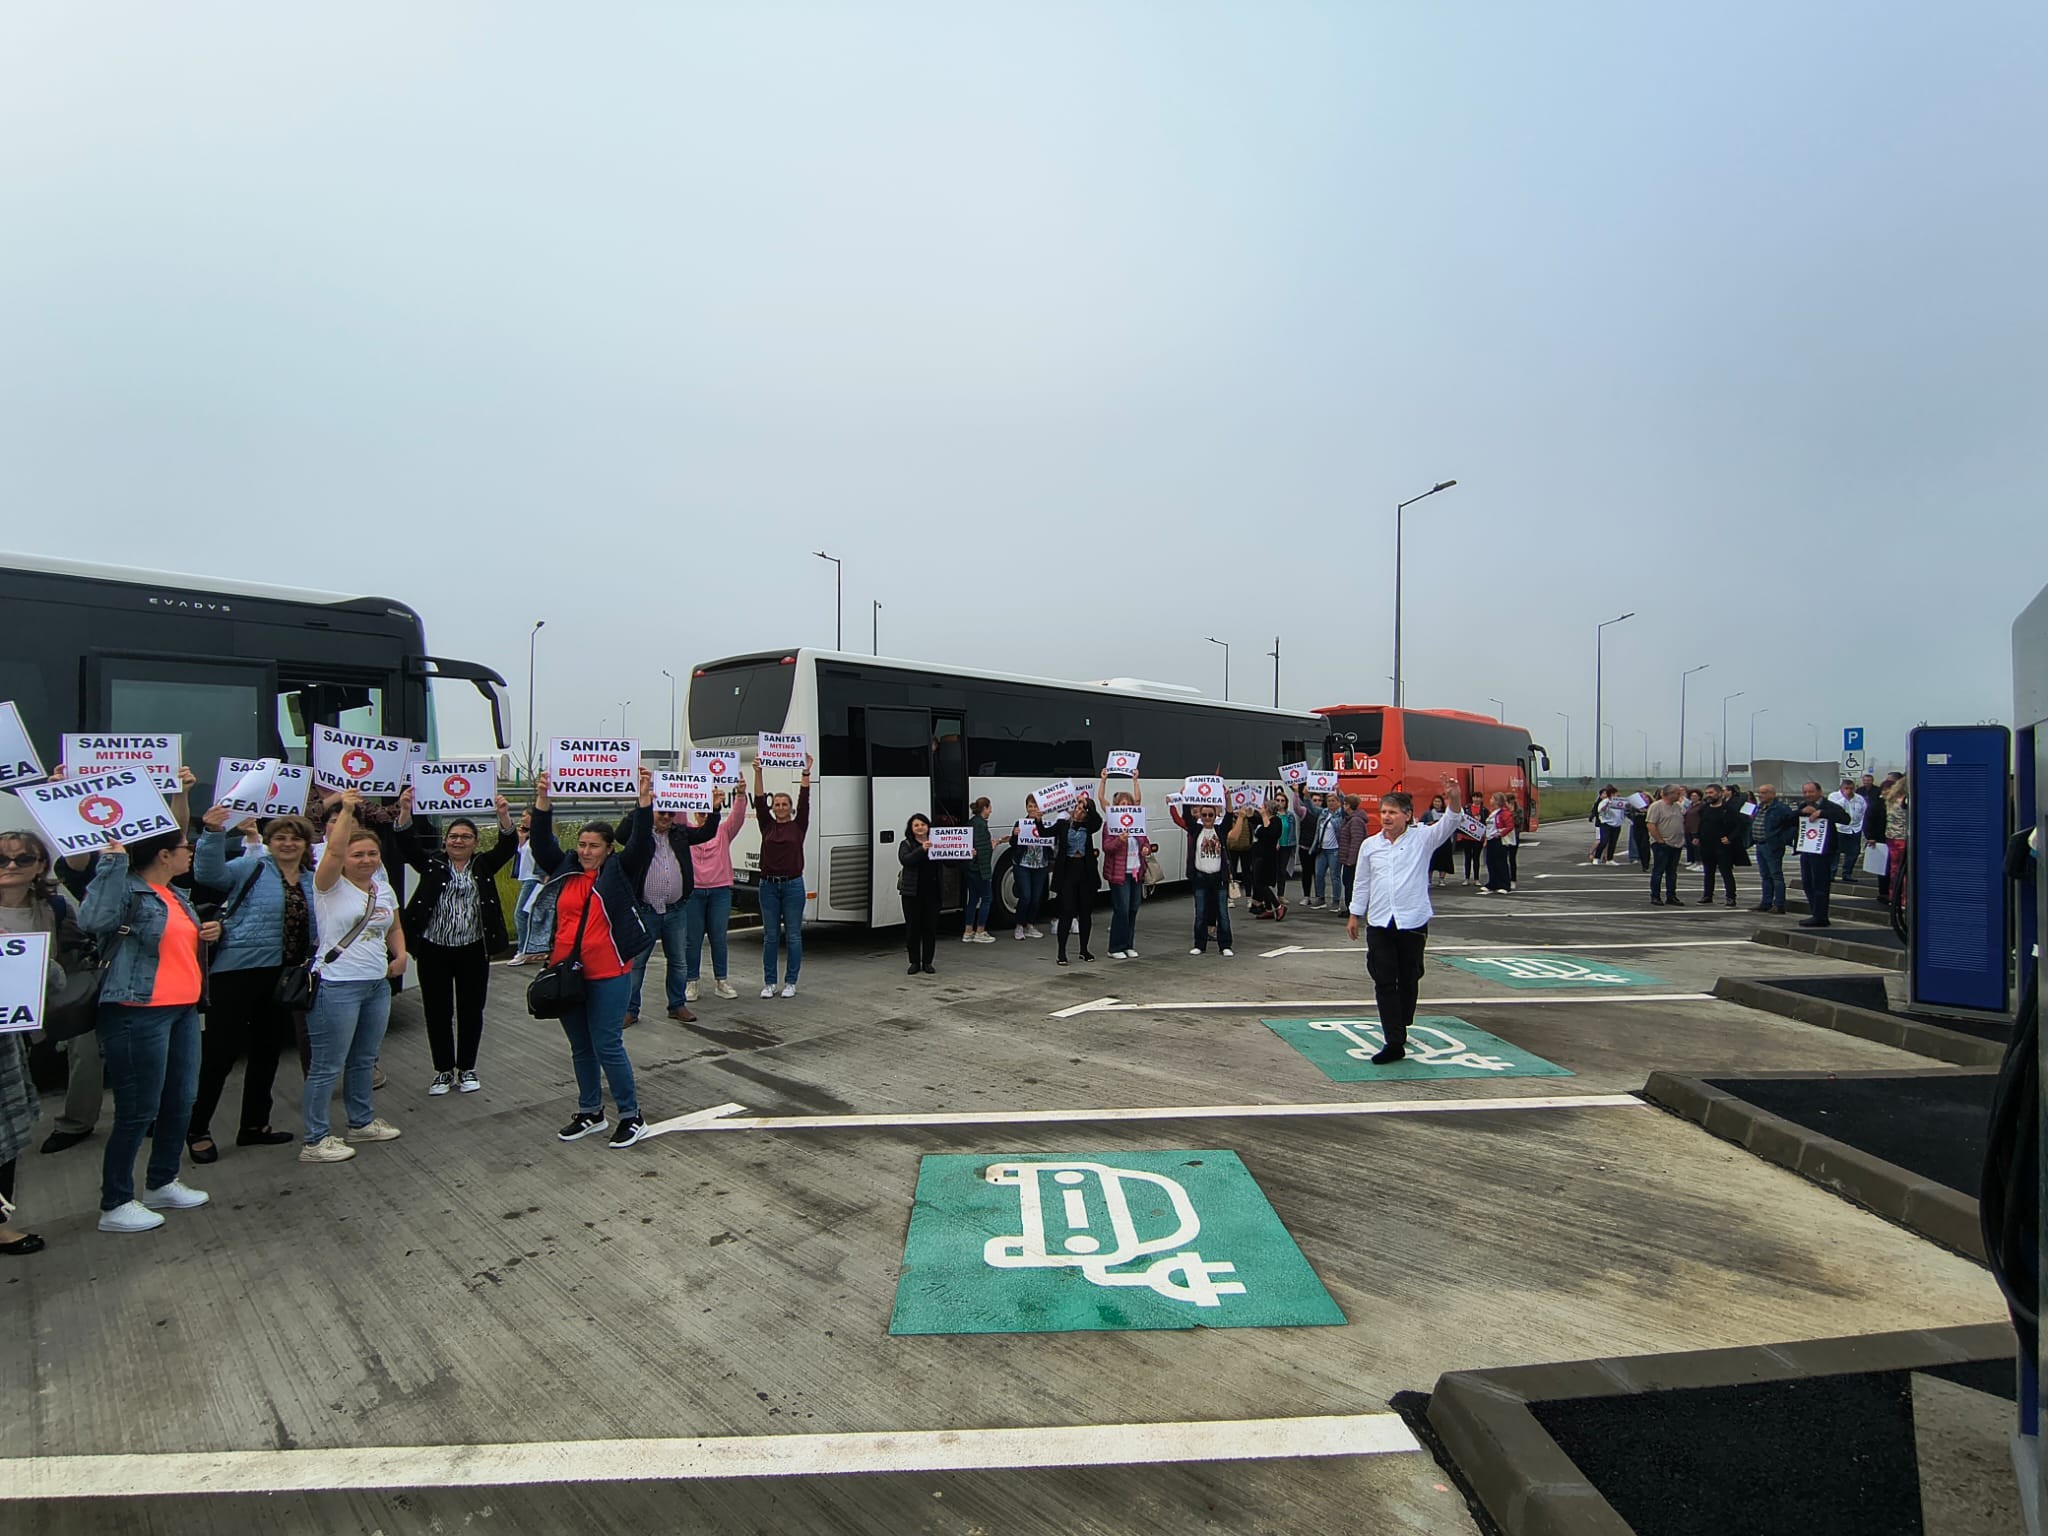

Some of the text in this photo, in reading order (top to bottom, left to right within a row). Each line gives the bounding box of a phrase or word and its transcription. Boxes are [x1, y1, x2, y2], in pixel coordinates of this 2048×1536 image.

[79, 738, 168, 749] SANITAS
[323, 730, 399, 752] SANITAS
[763, 734, 802, 743] SANITAS
[1848, 731, 1858, 745] P
[560, 740, 630, 751] SANITAS
[95, 751, 153, 760] MITING
[573, 754, 617, 762] MITING
[695, 750, 736, 759] SANITAS
[421, 763, 488, 774] SANITAS
[759, 758, 806, 768] VRANCEA
[559, 768, 631, 779] BUCUREȘTI
[661, 773, 707, 783] SANITAS
[317, 769, 396, 792] VRANCEA
[669, 782, 699, 790] MITING
[36, 772, 136, 802] SANITAS
[552, 781, 636, 793] VRANCEA
[1038, 781, 1069, 797] SANITAS
[417, 798, 494, 811] VRANCEA
[656, 800, 711, 810] VRANCEA
[58, 815, 172, 850] VRANCEA
[935, 828, 969, 836] SANITAS
[1019, 837, 1053, 845] VRANCEA
[930, 849, 971, 857] VRANCEA
